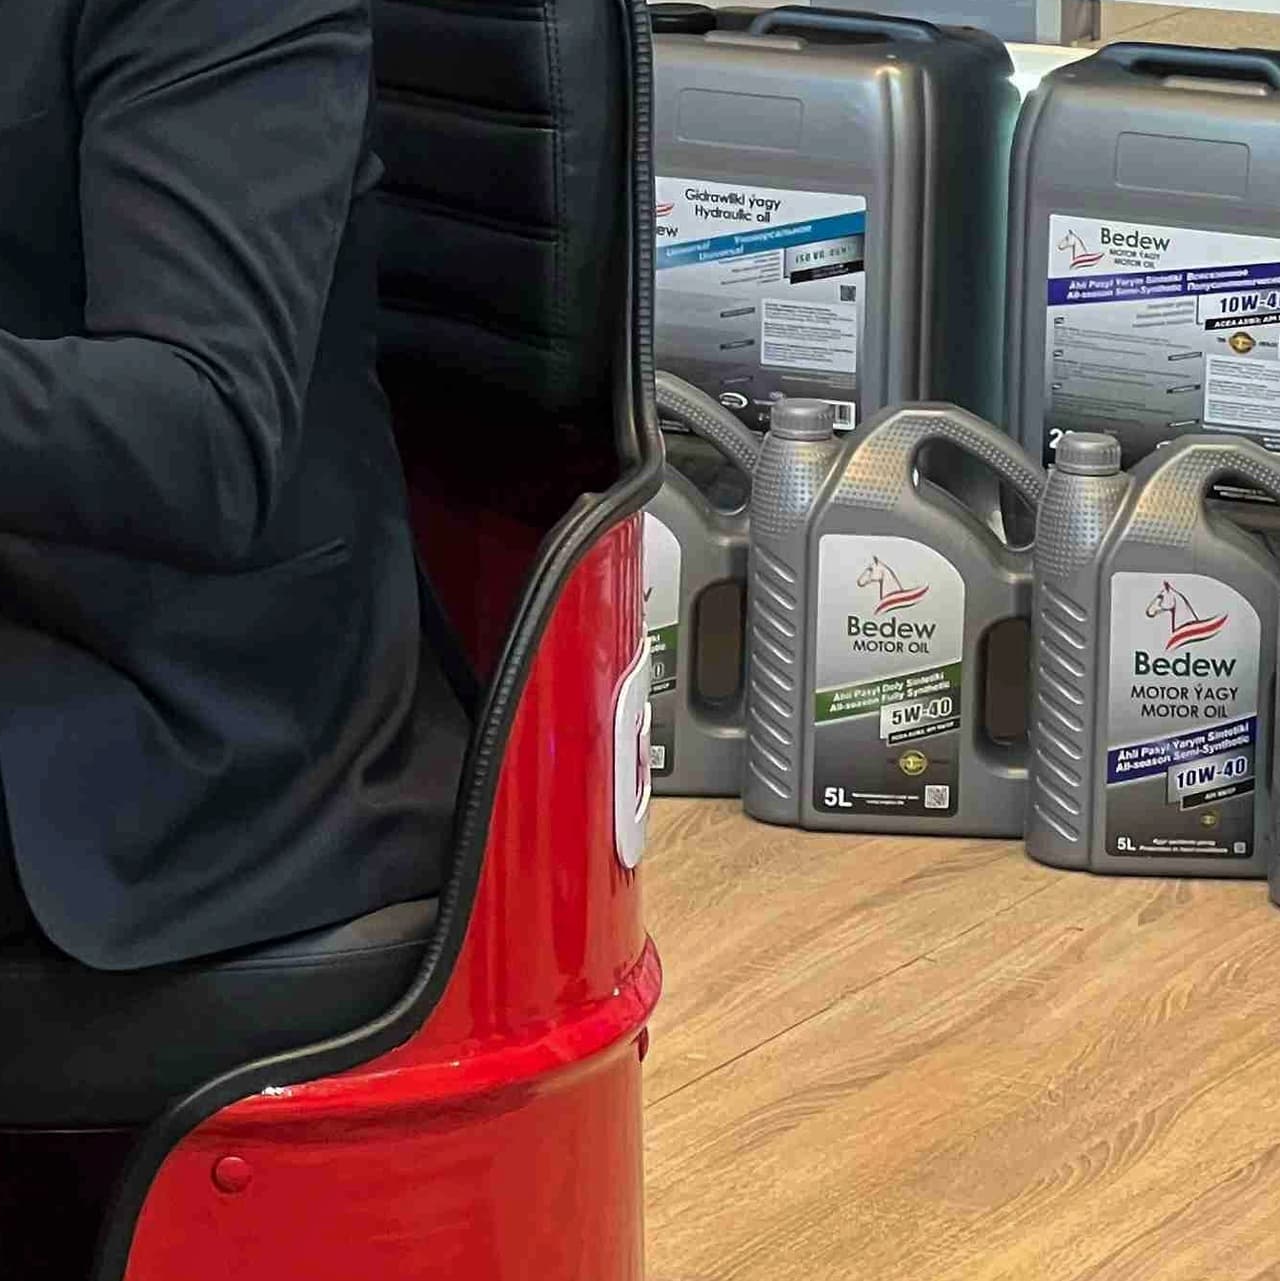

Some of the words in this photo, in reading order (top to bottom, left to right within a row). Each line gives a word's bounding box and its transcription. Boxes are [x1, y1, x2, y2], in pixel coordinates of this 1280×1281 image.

[694, 204, 752, 221] Hydraulic
[756, 209, 771, 223] oil
[1100, 226, 1171, 252] Bedew
[1109, 248, 1138, 259] MOTOR
[1114, 258, 1142, 268] MOTOR
[1220, 292, 1280, 313] 10W-4
[847, 615, 936, 639] Bedew
[852, 639, 904, 653] MOTOR
[908, 640, 930, 654] OIL
[1134, 650, 1237, 677] Bedew
[1131, 685, 1189, 700] MOTOR
[1195, 682, 1239, 701] ÝAGY
[891, 697, 953, 726] 5W-40
[1141, 704, 1199, 719] MOTOR
[1203, 704, 1228, 719] OIL
[1177, 756, 1248, 790] 10W-40
[824, 786, 853, 808] 5L
[1117, 837, 1136, 851] 5L
